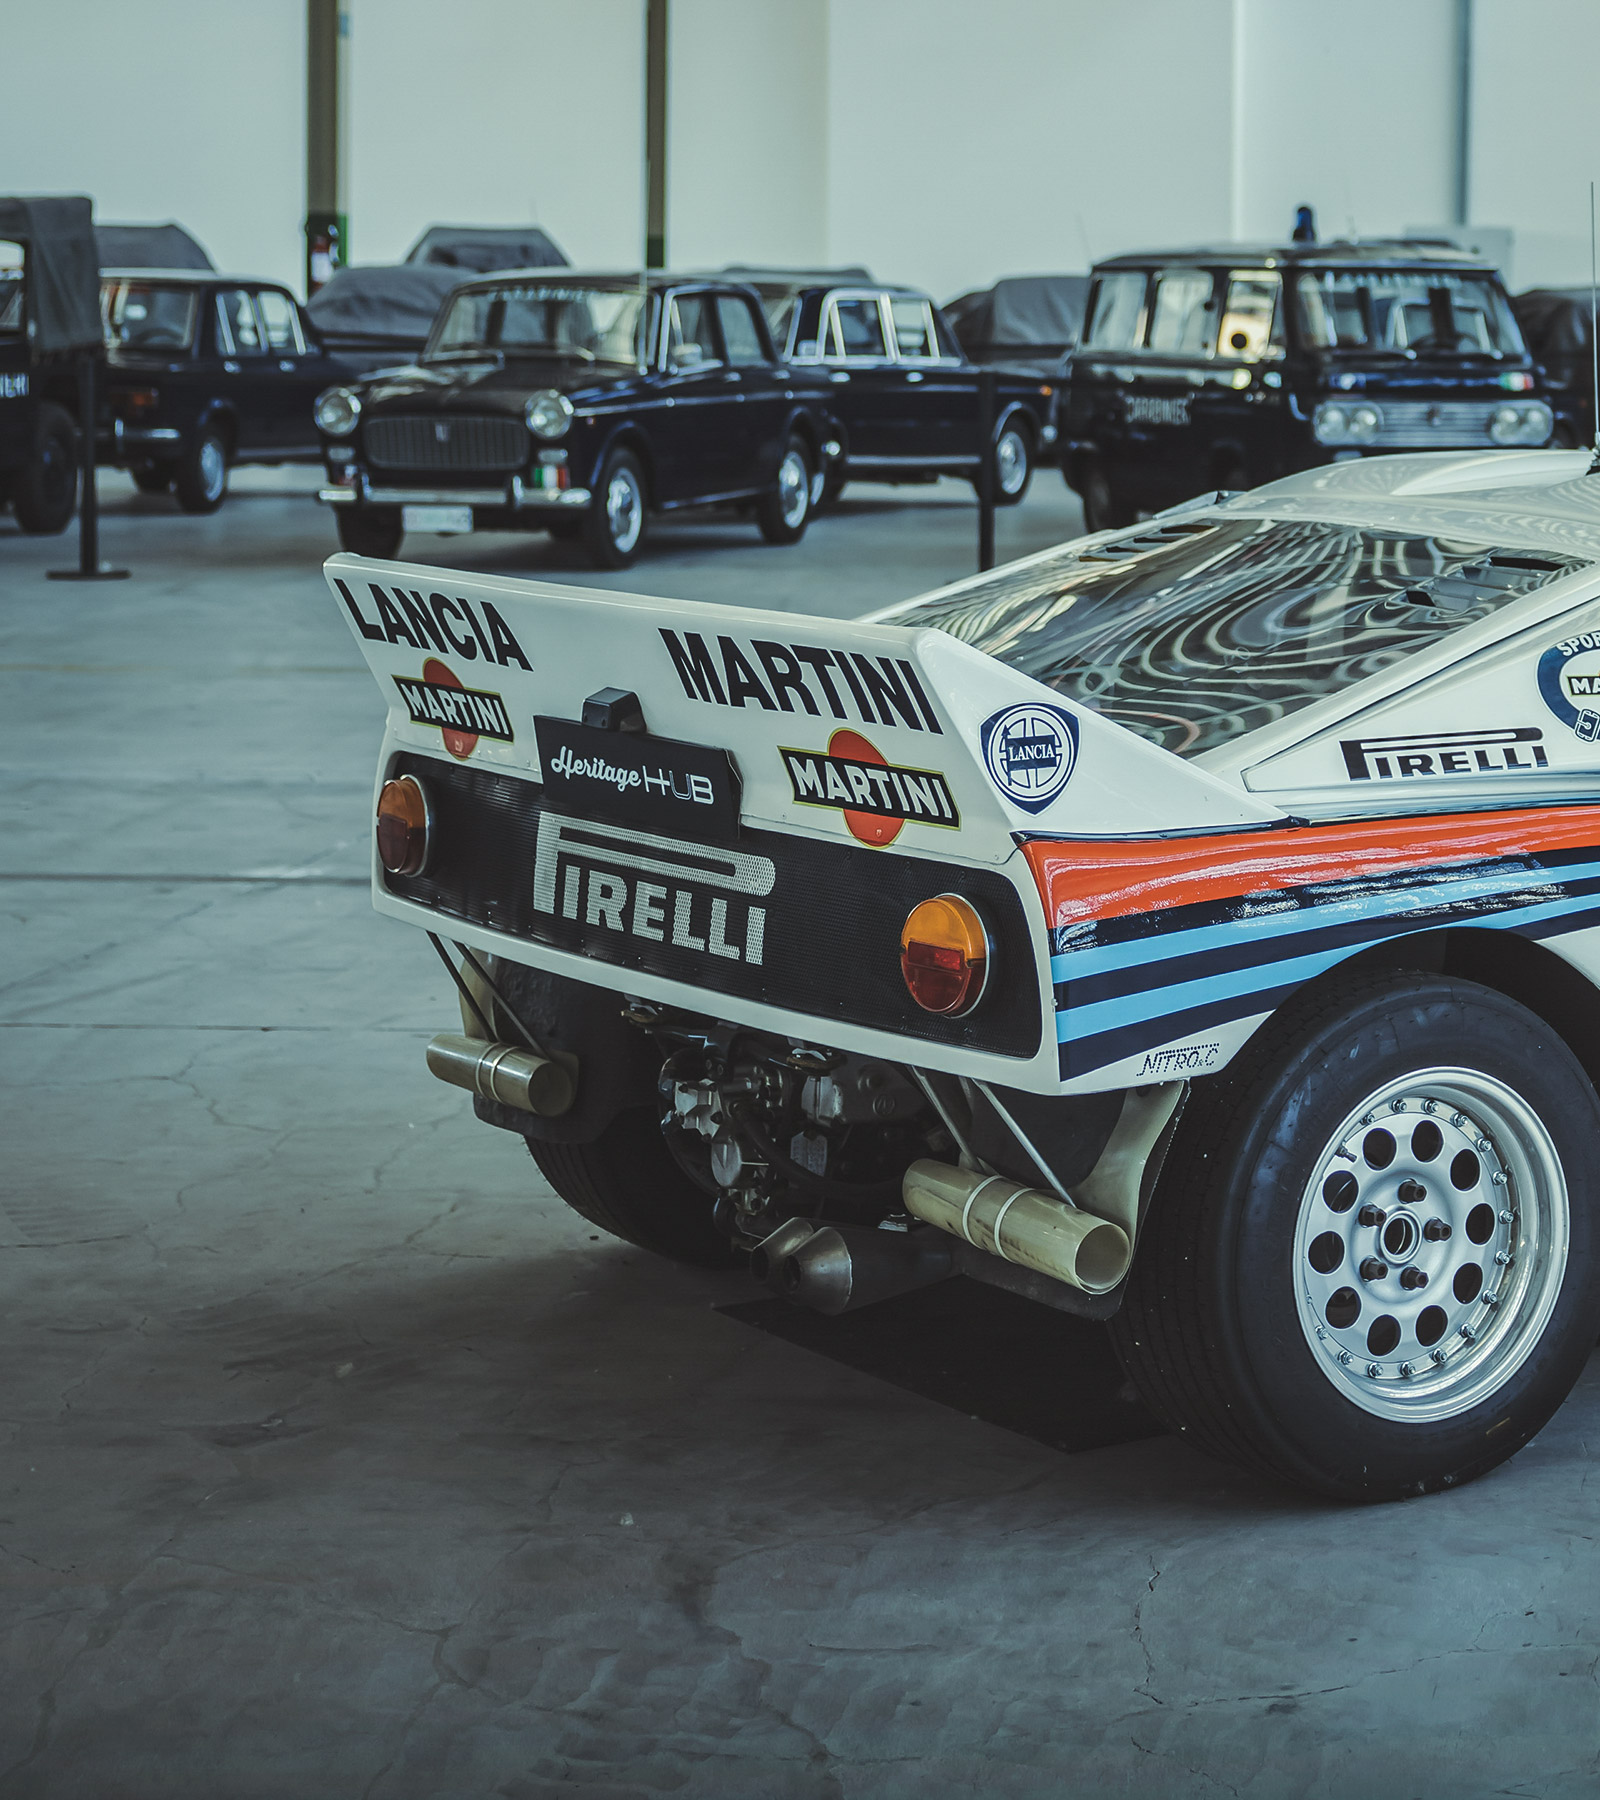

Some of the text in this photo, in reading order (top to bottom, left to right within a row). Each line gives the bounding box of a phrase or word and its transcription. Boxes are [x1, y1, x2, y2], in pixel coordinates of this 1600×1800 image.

[334, 577, 534, 672] LANCIA
[400, 682, 510, 735] MARTINI
[658, 628, 944, 735] MARTINI
[550, 746, 714, 805] Heritage HUB
[1008, 743, 1055, 761] LANCIA
[1339, 727, 1550, 781] PIRELLI
[788, 757, 953, 819] MARTINI
[533, 811, 776, 965] PIRELLI
